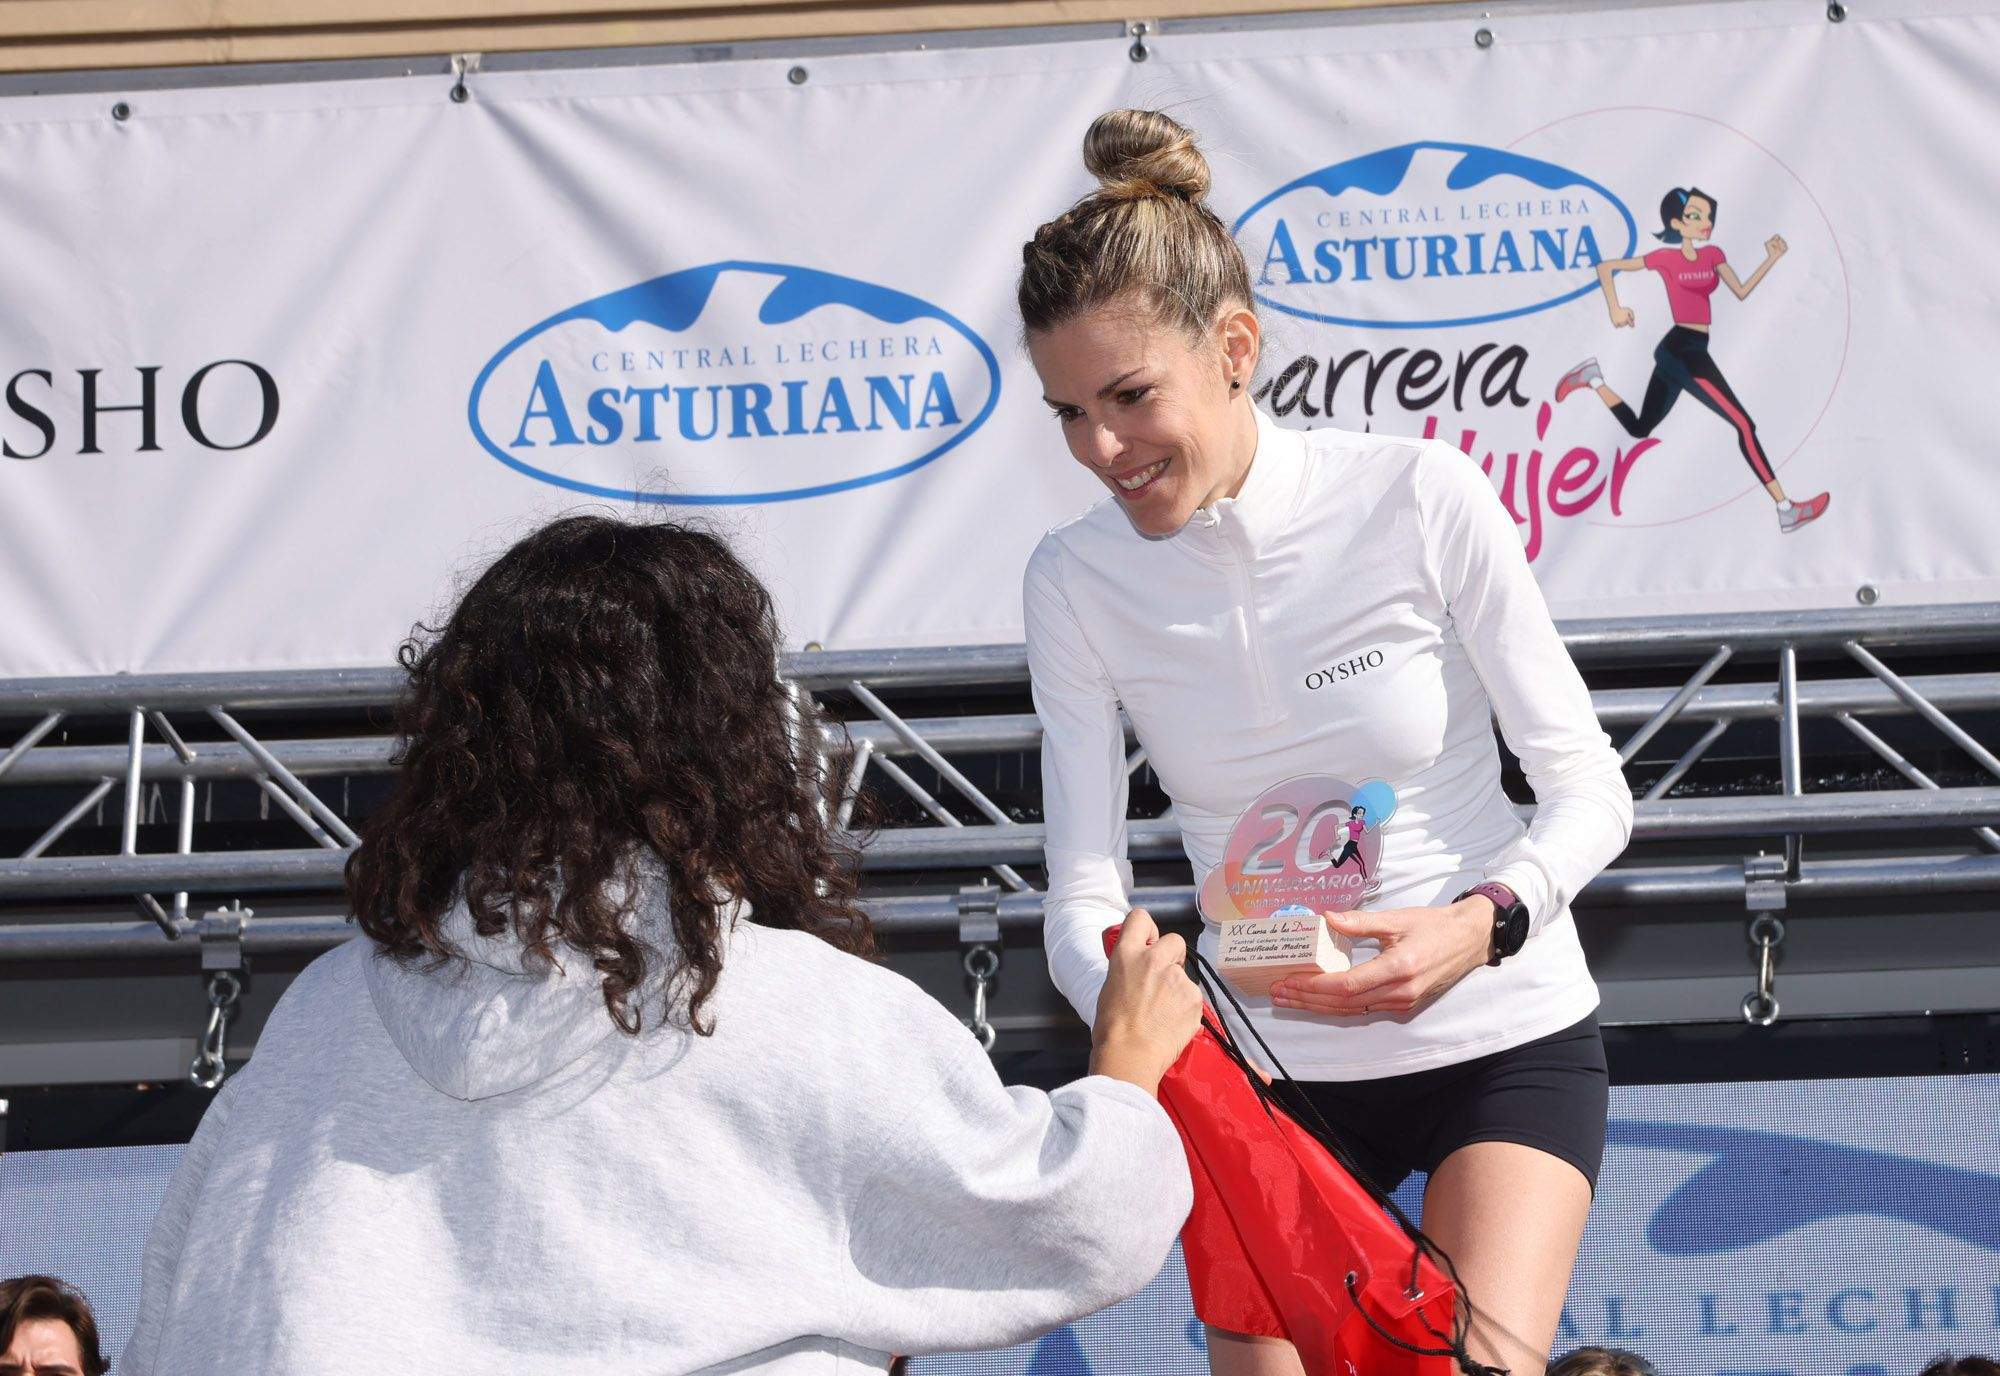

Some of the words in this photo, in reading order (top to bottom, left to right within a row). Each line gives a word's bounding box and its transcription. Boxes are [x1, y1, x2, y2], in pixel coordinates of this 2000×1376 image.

[1317, 206, 1446, 228] CENTRAL
[1460, 199, 1590, 221] LECHERA
[592, 347, 756, 373] CENTRAL
[776, 336, 943, 364] LECHERA
[1253, 343, 1531, 418] arrera
[1305, 650, 1384, 690] OYSHO
[1226, 874, 1361, 896] ANIVERSARIO
[1227, 923, 1246, 936] XX
[1247, 923, 1267, 936] Cursa
[1269, 924, 1278, 934] de
[1281, 922, 1290, 933] les
[1291, 920, 1316, 932] Dones
[1281, 943, 1310, 951] Madres
[1701, 1286, 2000, 1336] LECH
